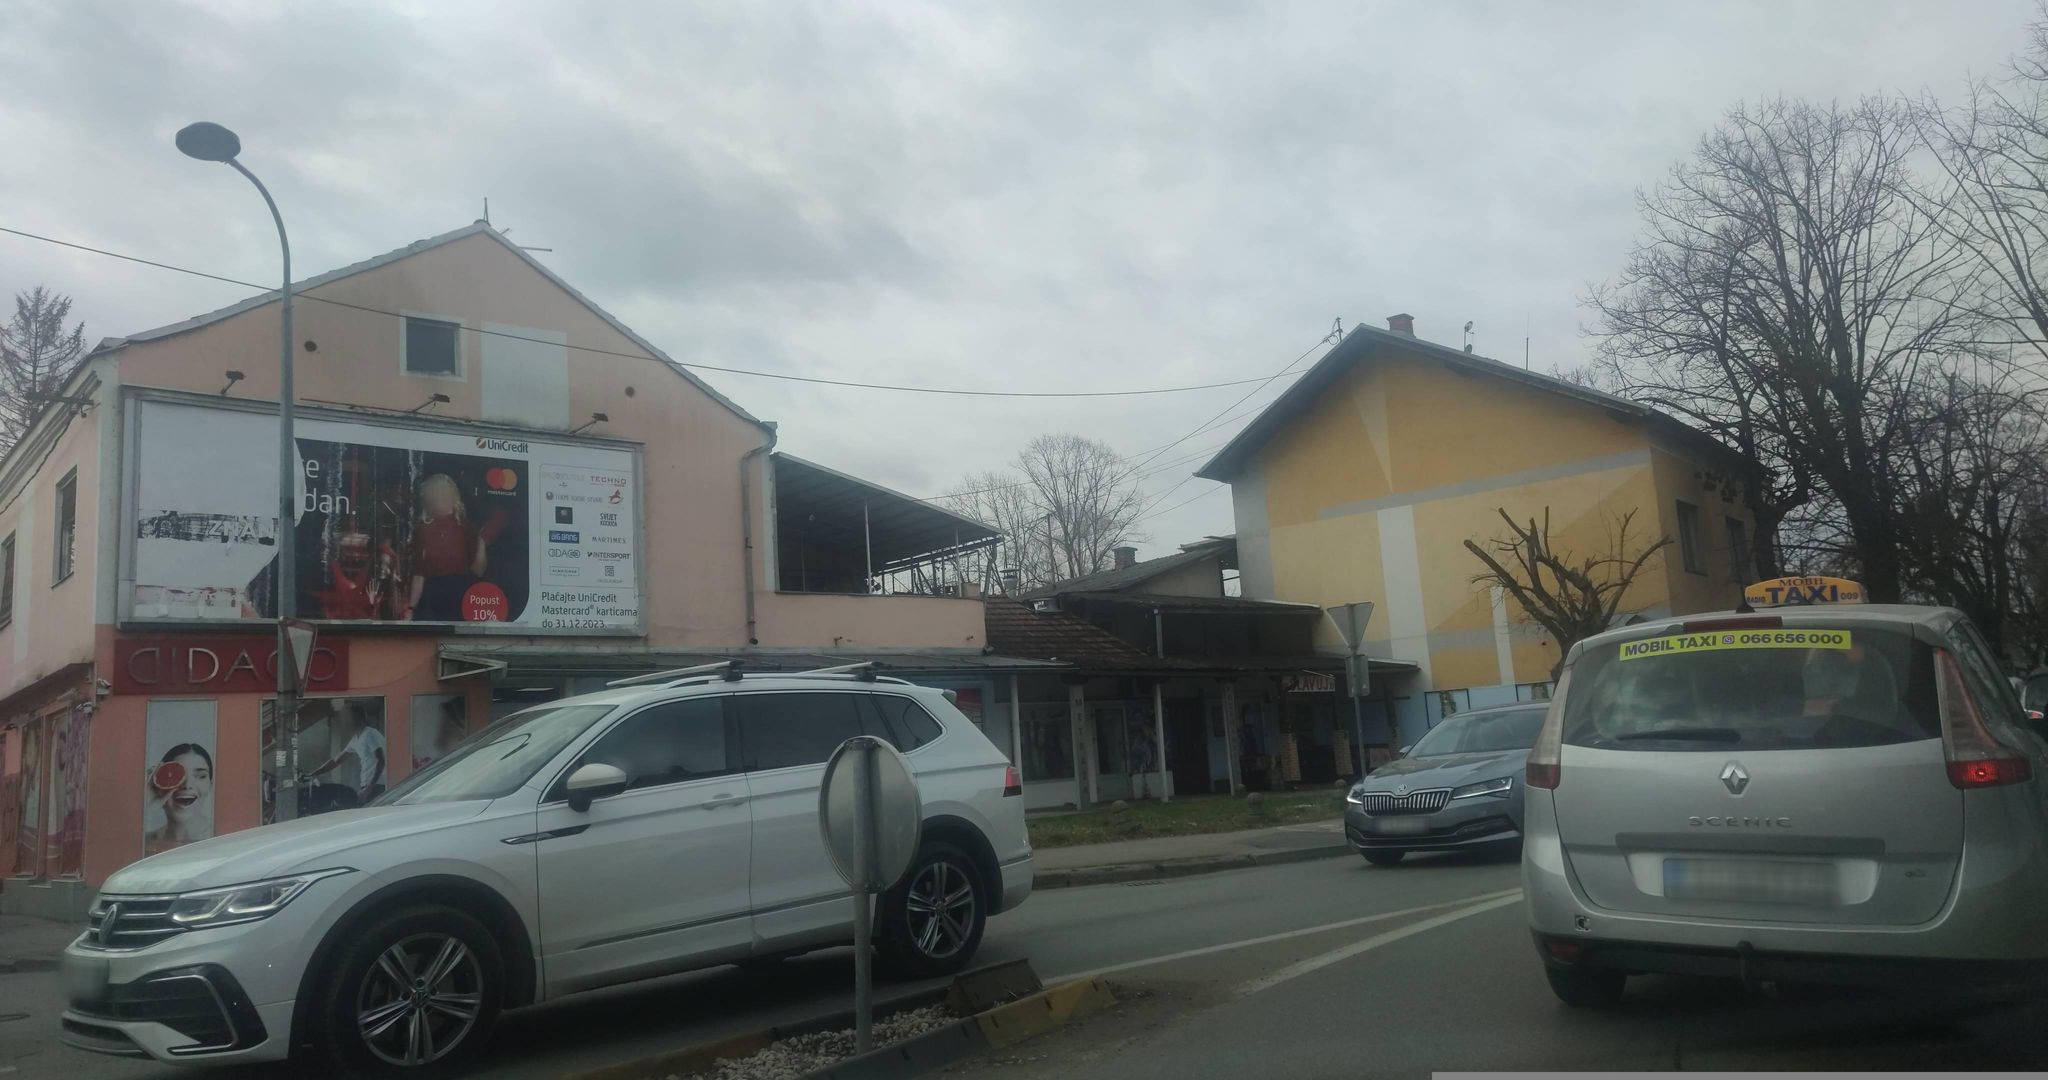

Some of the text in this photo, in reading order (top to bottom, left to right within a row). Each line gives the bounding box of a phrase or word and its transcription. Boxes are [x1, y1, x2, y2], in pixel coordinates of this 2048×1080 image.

[487, 439, 529, 454] UniCredit
[590, 475, 627, 485] TECHNO
[303, 487, 357, 516] dan.
[592, 551, 631, 560] INTERSPORT
[1779, 578, 1827, 587] MOBIL
[470, 595, 501, 606] Popust
[541, 591, 617, 604] Plaćajte UniCredit
[1765, 584, 1839, 605] TAXI
[1840, 592, 1859, 600] 009
[472, 609, 497, 621] 10%
[596, 606, 638, 617] karticama
[542, 619, 554, 628] do
[1624, 633, 1843, 657] MOBIL TAXI 066 656 000
[1688, 815, 1792, 828] SCENIC
